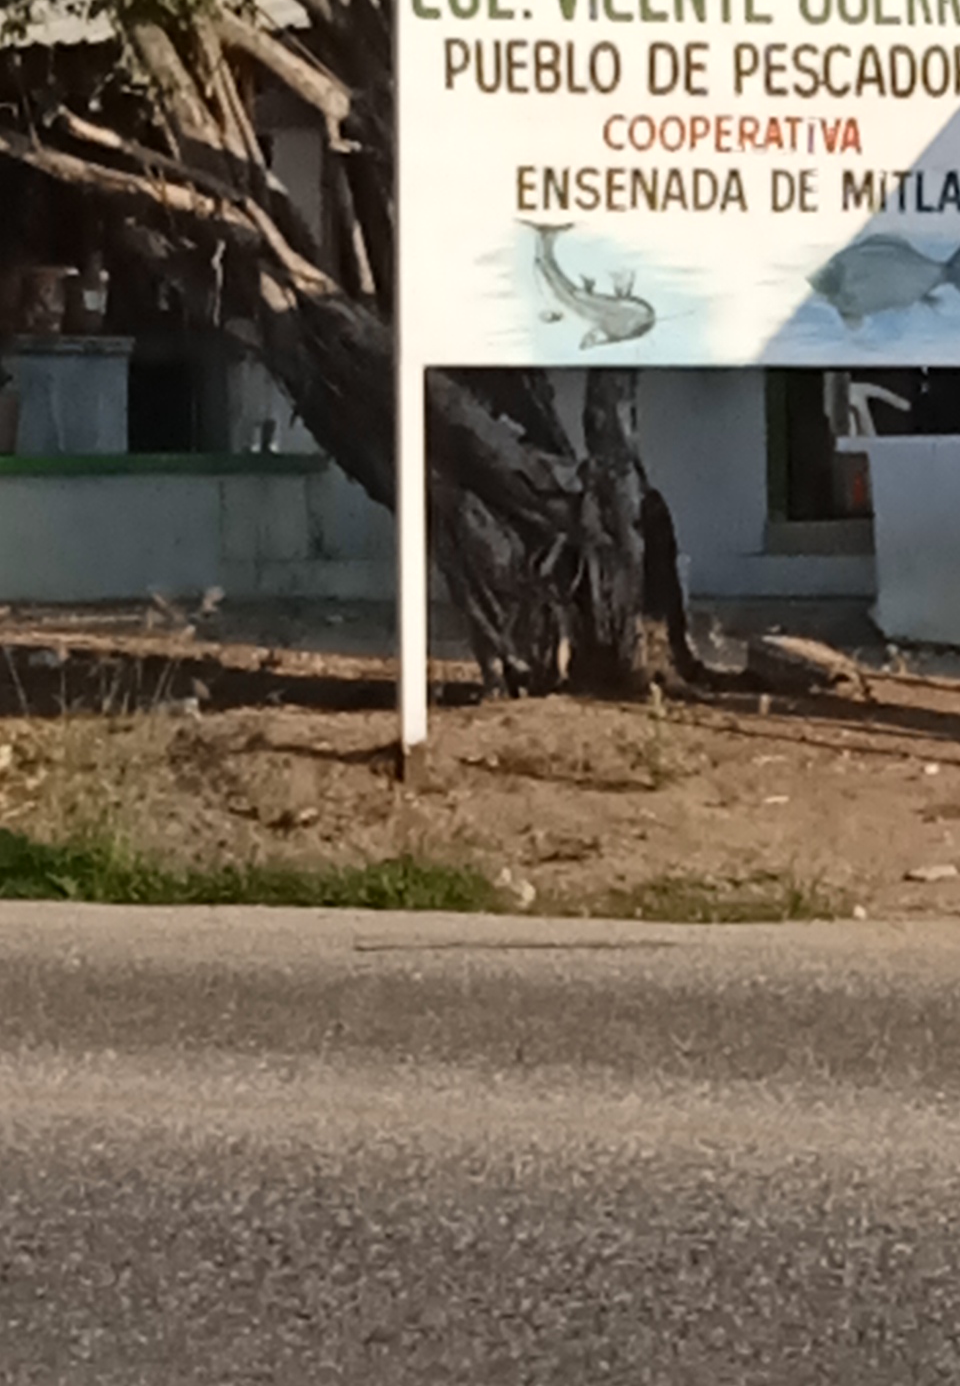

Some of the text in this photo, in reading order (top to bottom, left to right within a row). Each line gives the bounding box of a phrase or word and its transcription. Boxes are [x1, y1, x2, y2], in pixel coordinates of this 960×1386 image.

[444, 38, 621, 95] PUEBLO
[647, 41, 709, 96] DE
[516, 165, 748, 212] ENSENADA
[771, 169, 817, 213] DE
